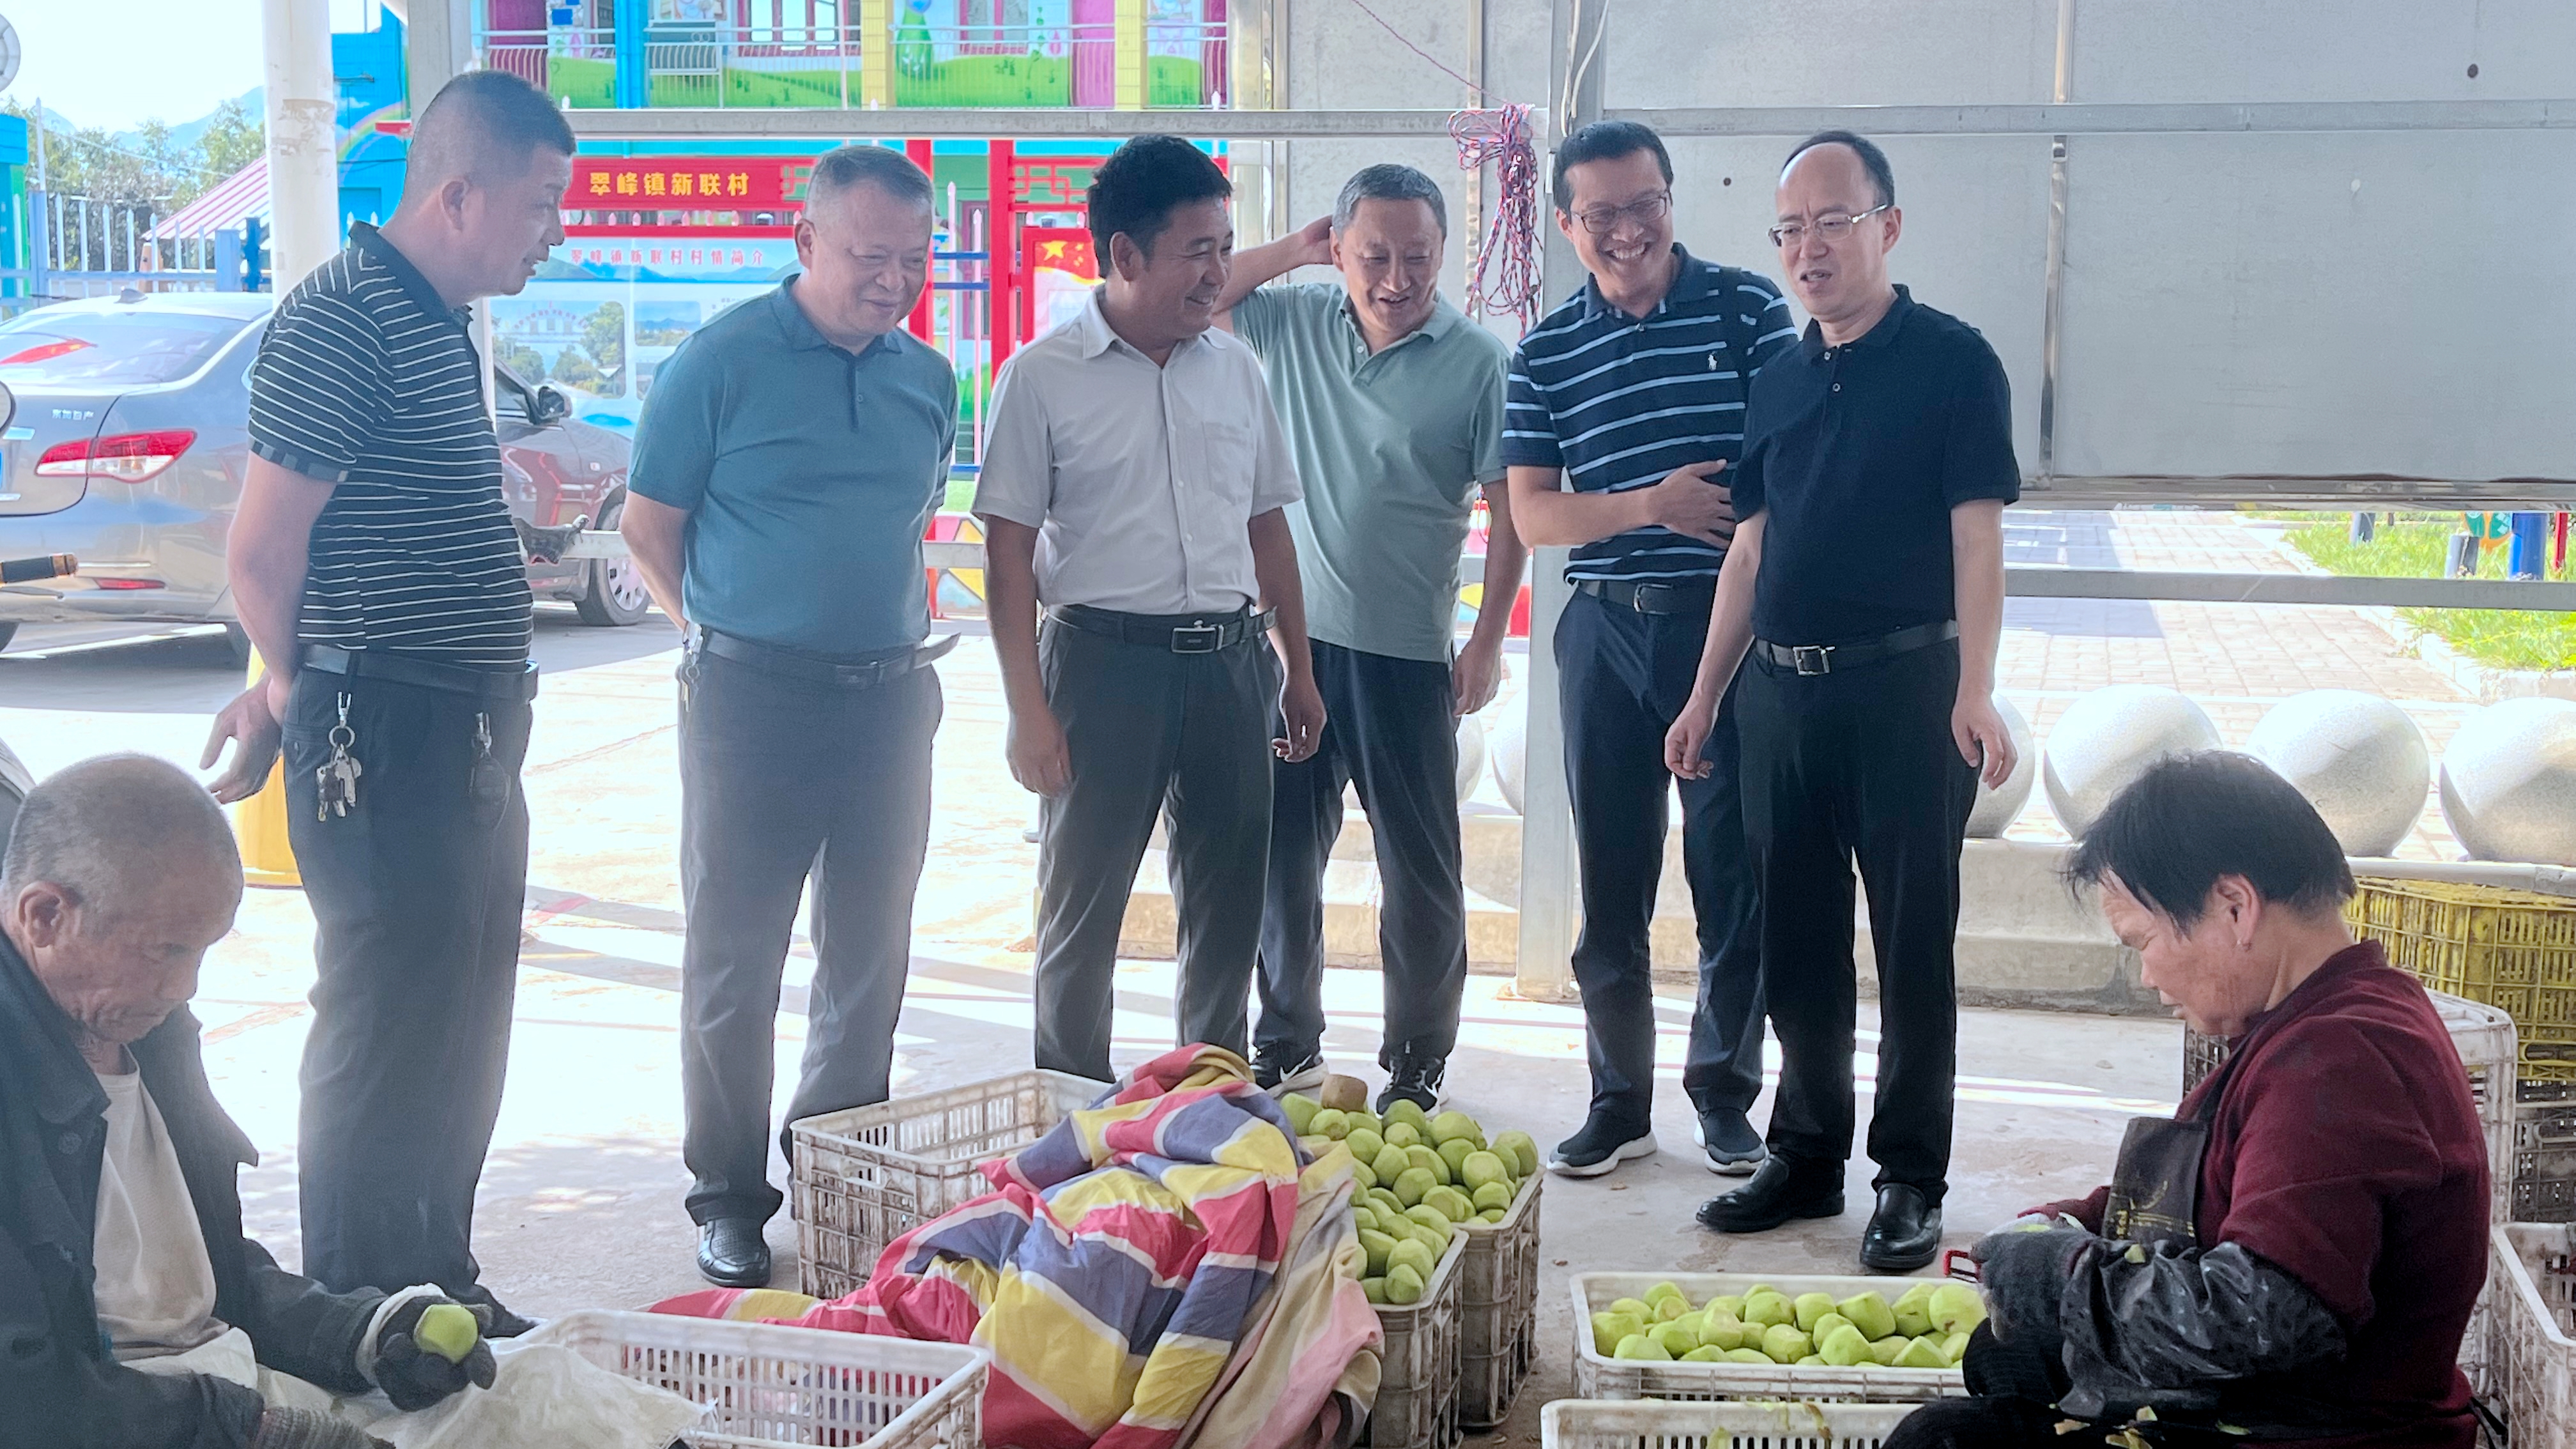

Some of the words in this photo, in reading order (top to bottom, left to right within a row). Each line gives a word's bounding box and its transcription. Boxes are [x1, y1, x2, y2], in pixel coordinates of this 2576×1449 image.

[589, 171, 749, 196] 翠峰镇新联村
[570, 249, 763, 265] 翠峰镇新联村村情简介
